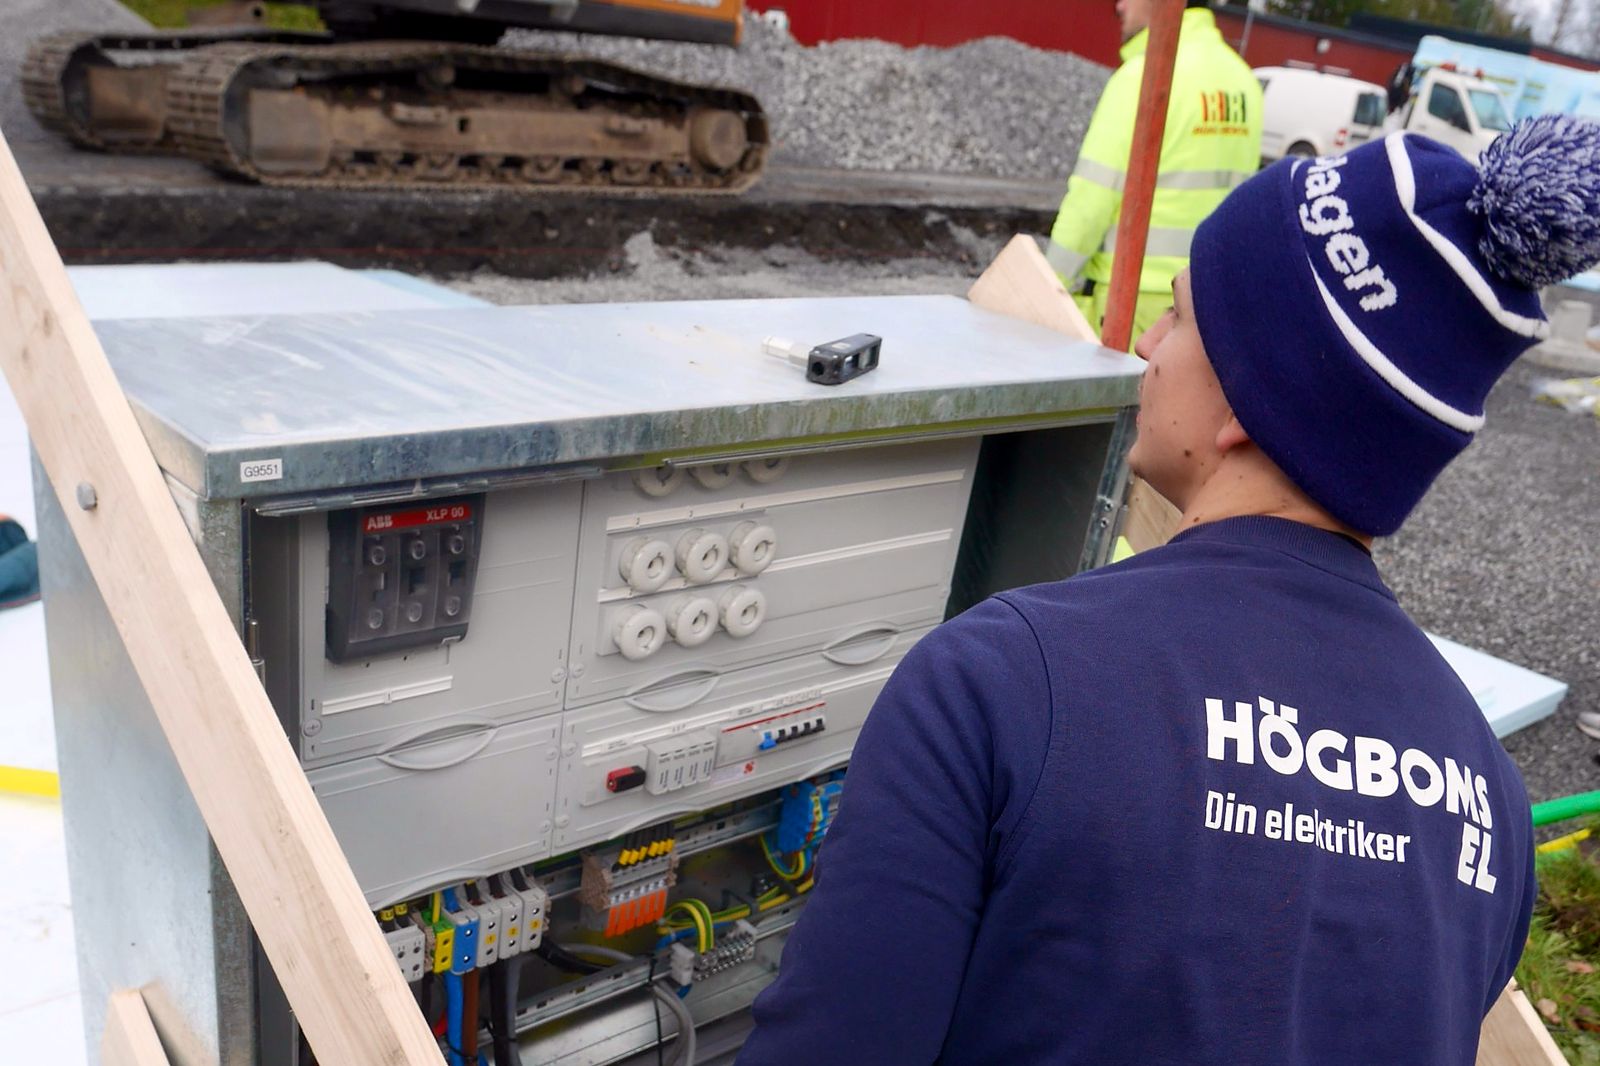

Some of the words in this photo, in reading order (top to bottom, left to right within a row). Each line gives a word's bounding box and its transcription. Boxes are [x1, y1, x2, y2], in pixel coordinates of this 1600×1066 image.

[243, 464, 279, 477] G9551
[366, 514, 393, 530] ABB
[426, 509, 449, 522] XLP
[451, 506, 464, 518] 00
[1204, 696, 1493, 830] HÖGBOMS
[1204, 790, 1257, 834] Din
[1264, 802, 1411, 863] elektriker
[1457, 821, 1497, 895] EL
